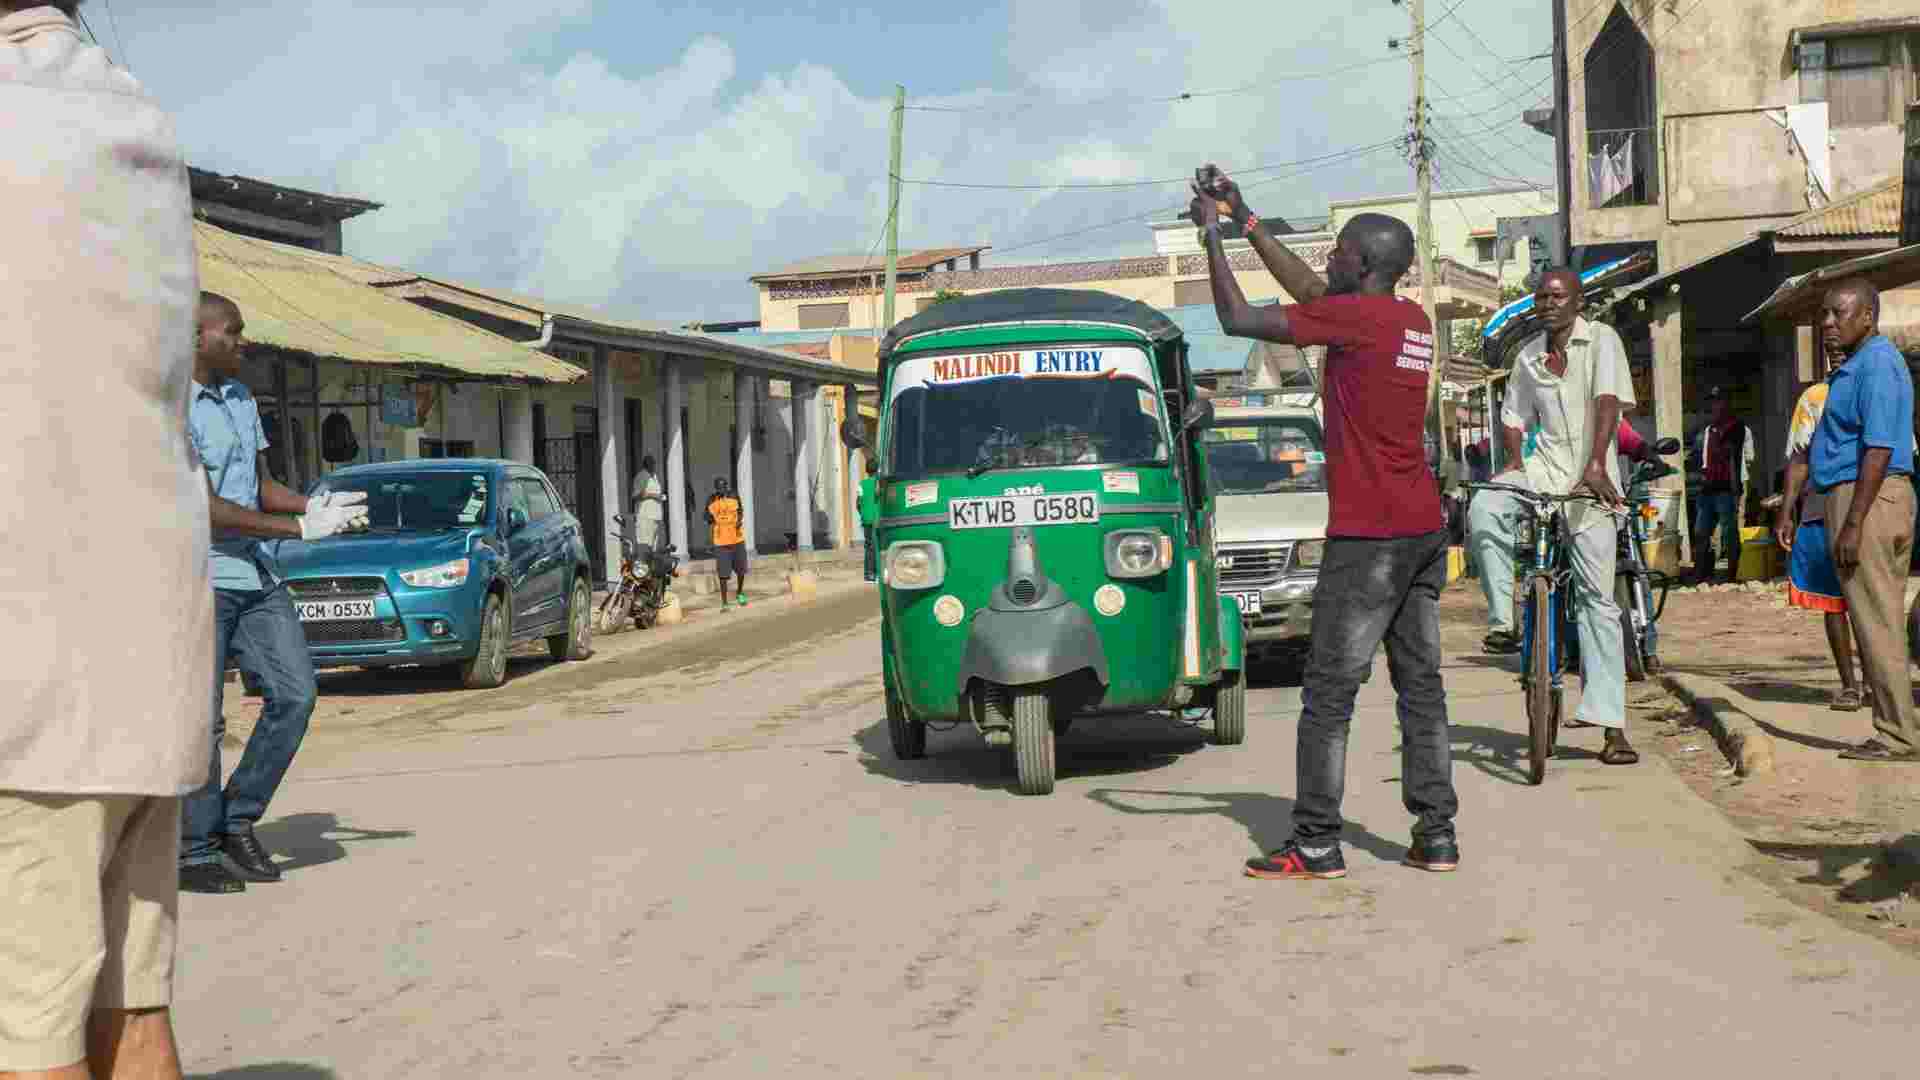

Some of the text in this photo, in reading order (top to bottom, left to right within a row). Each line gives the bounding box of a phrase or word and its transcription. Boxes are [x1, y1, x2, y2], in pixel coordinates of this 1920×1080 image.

[932, 351, 1103, 381] MALINDI ENTRY
[952, 496, 1096, 526] KTWB 058Q
[296, 602, 372, 618] KCM 053X
